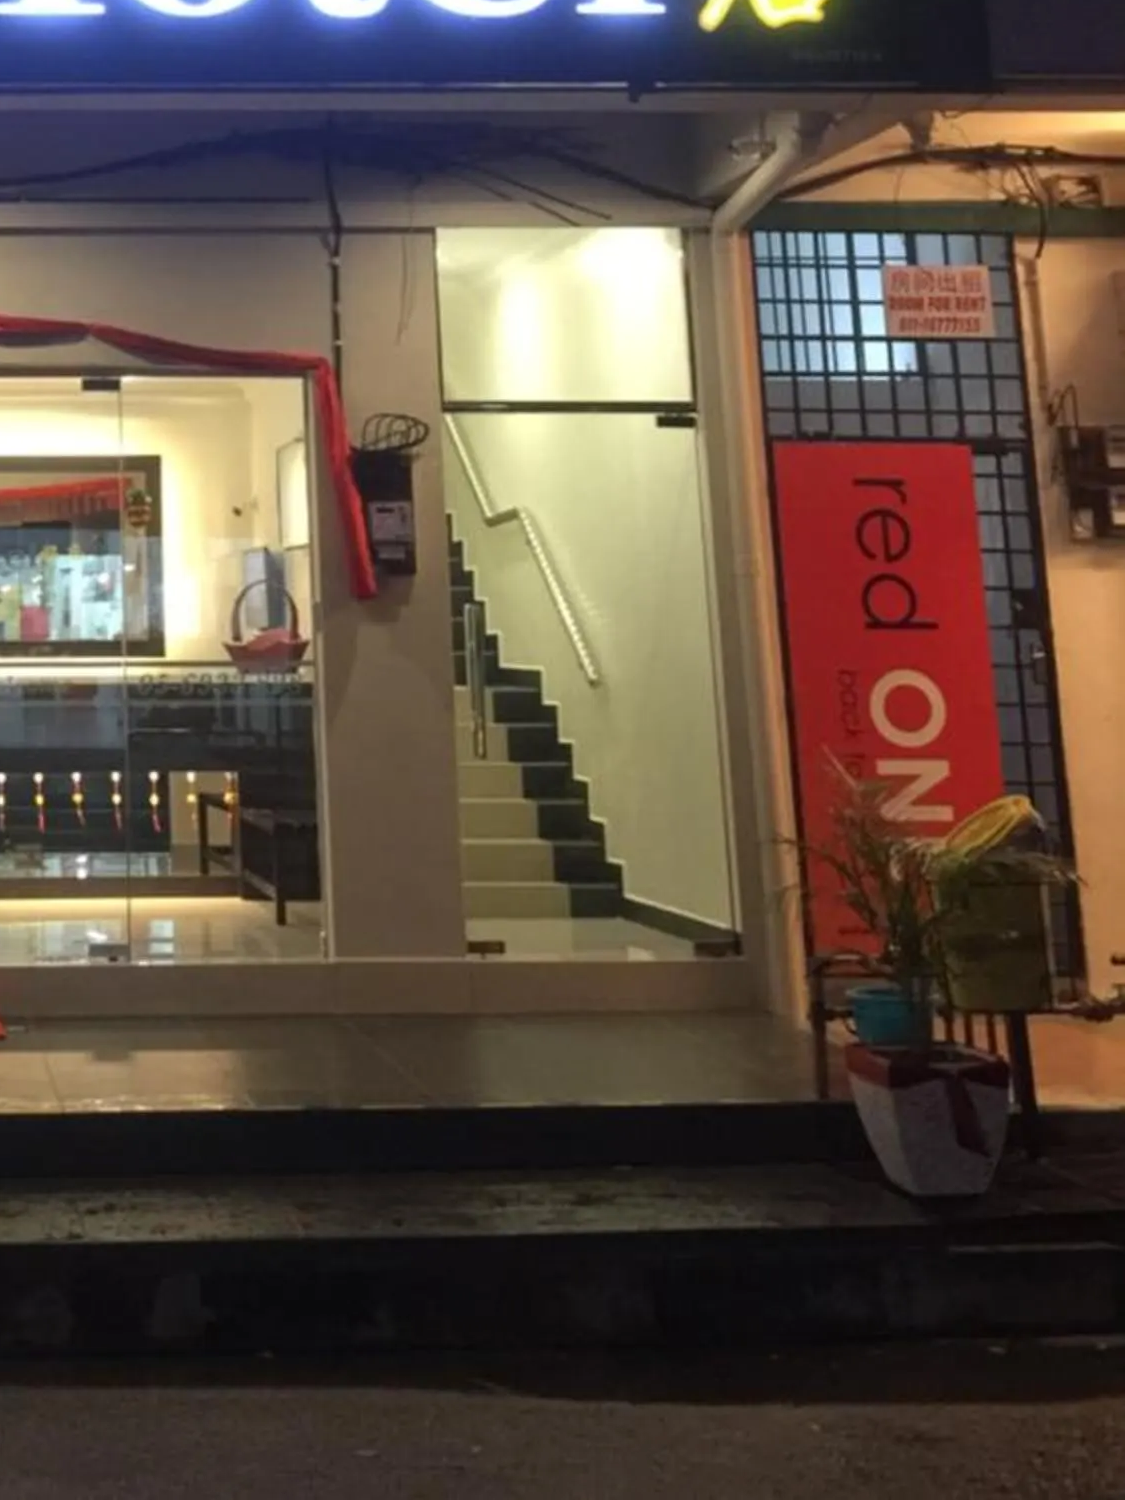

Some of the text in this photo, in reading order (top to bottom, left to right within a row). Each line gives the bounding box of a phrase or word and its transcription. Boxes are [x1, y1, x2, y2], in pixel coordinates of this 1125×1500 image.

[954, 296, 986, 312] RENT
[852, 475, 956, 845] red ON
